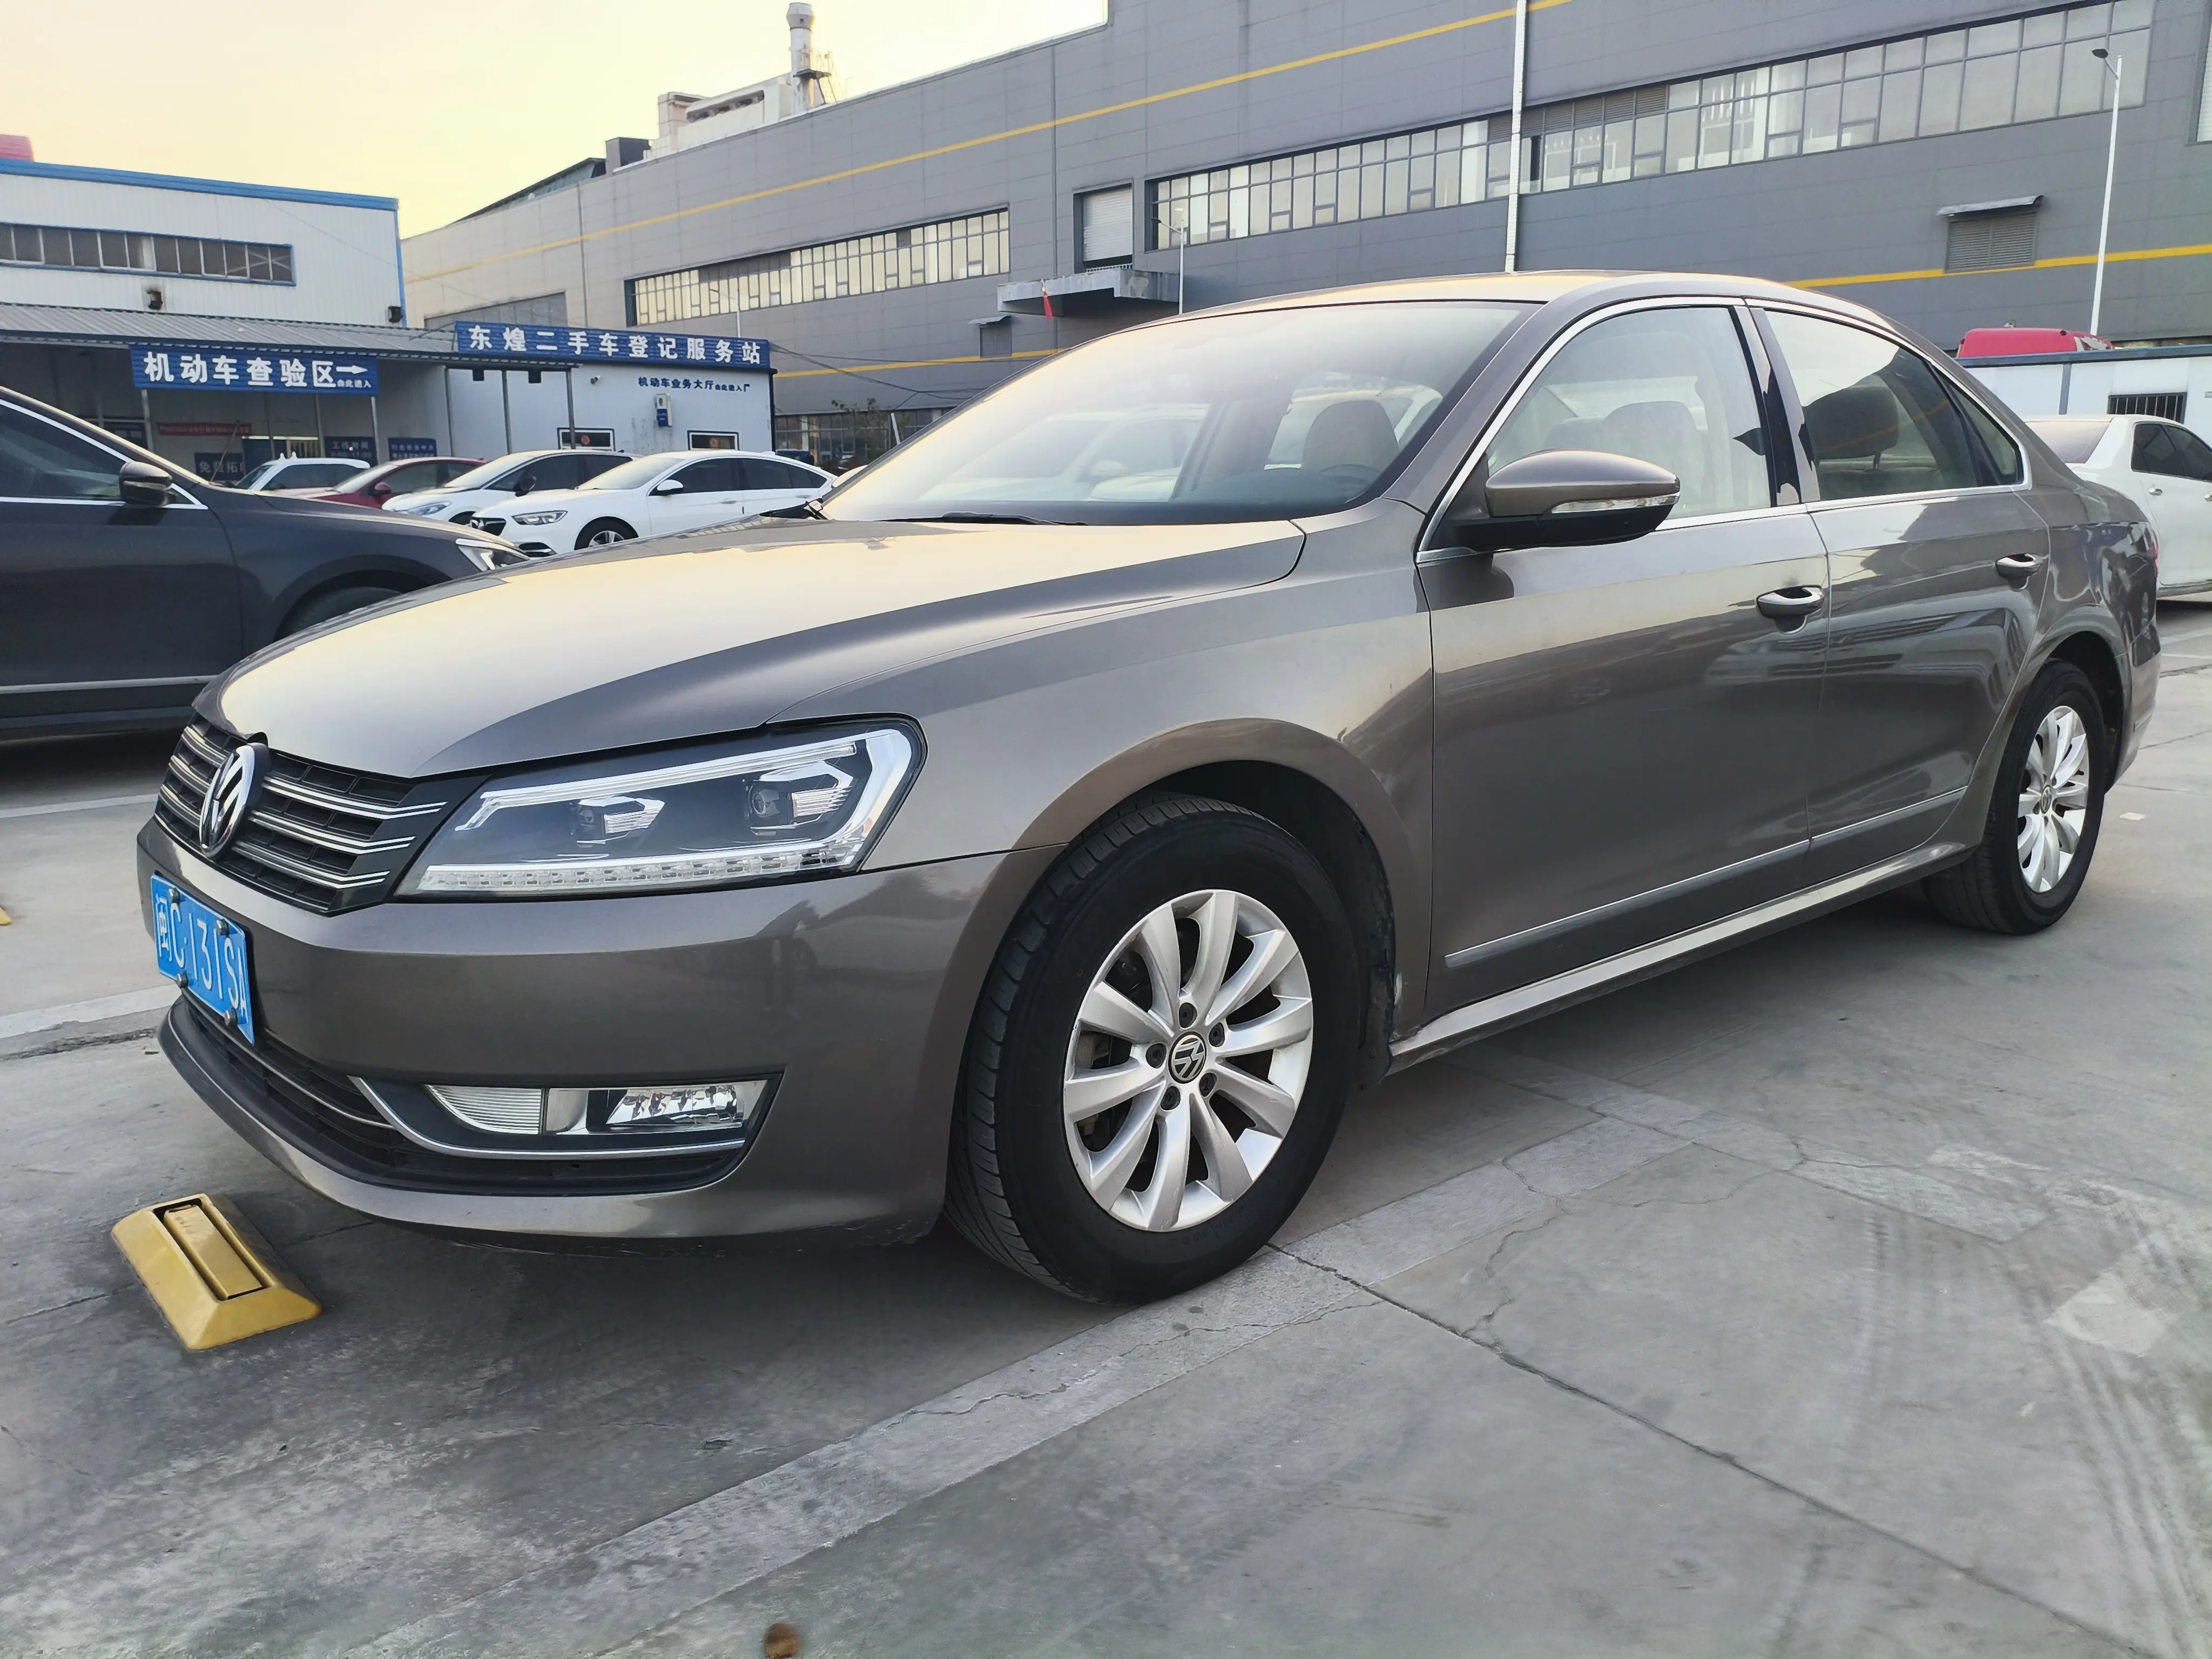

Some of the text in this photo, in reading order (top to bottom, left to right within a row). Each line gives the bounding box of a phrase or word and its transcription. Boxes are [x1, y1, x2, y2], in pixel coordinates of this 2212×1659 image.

[468, 325, 760, 365] 东煌二手车登记服务站
[144, 351, 336, 387] 机动车查验区
